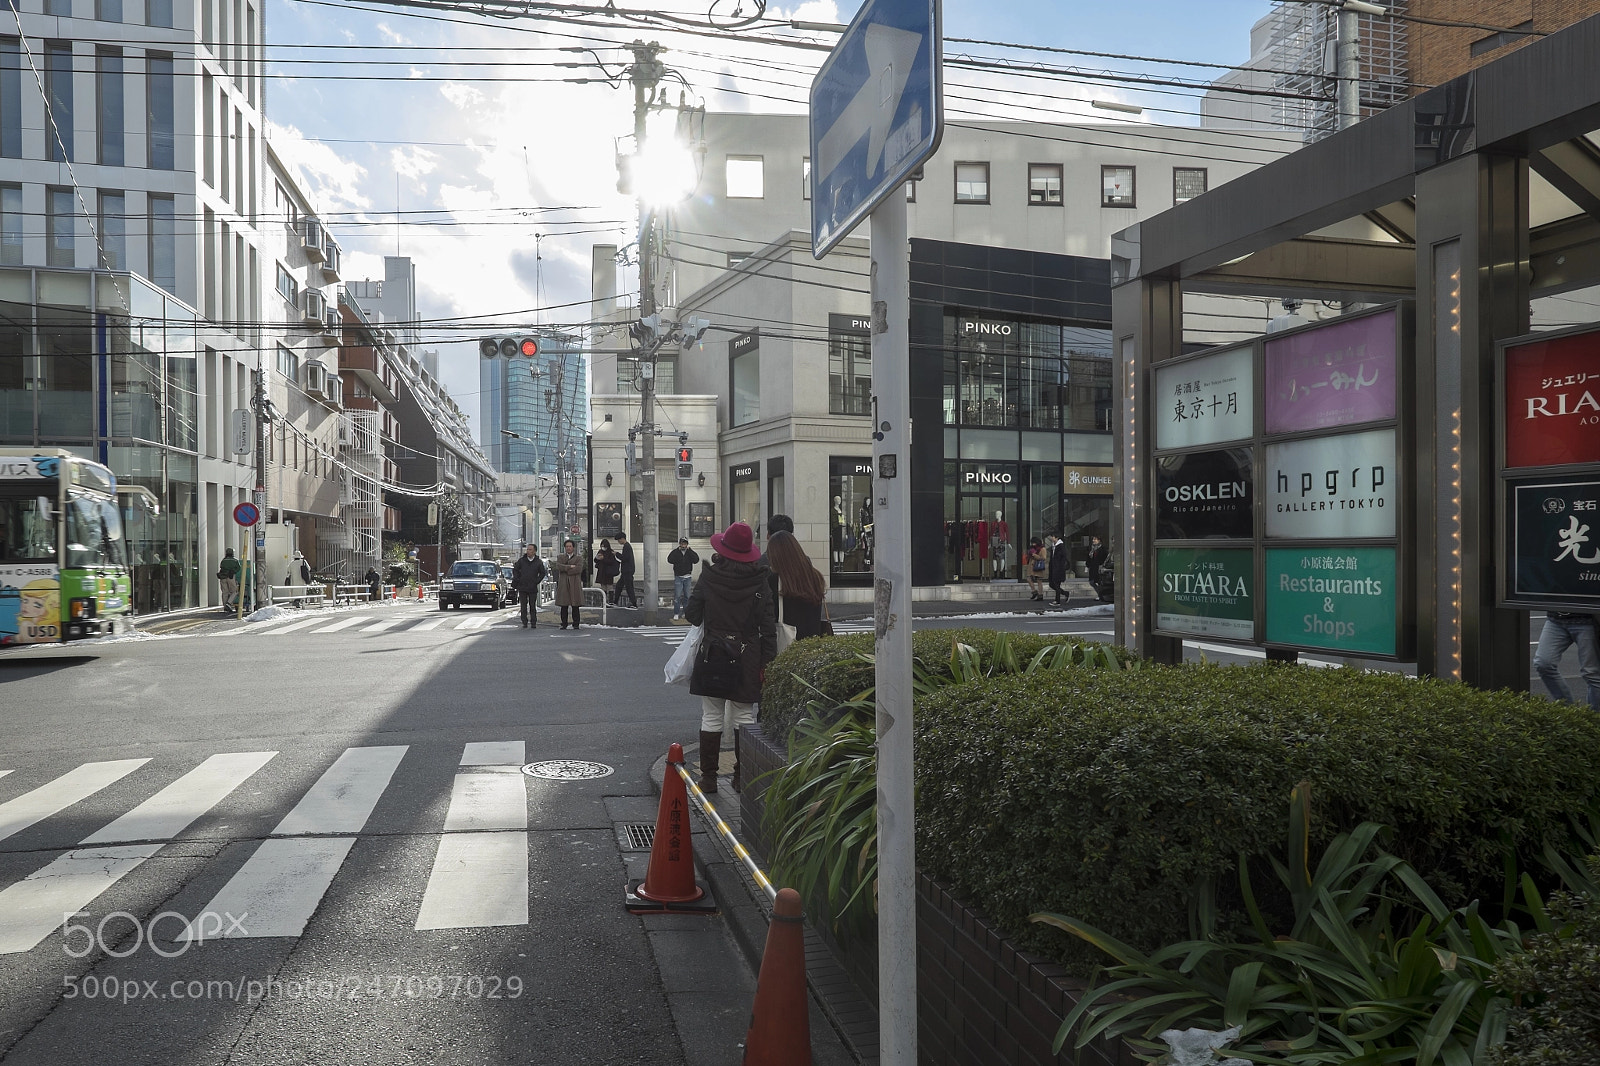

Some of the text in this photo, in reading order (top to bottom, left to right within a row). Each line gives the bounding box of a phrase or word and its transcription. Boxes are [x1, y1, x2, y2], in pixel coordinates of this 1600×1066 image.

[966, 322, 1012, 335] PINKO
[734, 336, 751, 349] PINKO
[1174, 380, 1202, 396] 居酒屋
[1541, 372, 1600, 389] ジュエリー
[1173, 392, 1238, 423] 東京十月
[1524, 390, 1600, 420] RIA
[1580, 415, 1600, 425] AO
[735, 467, 752, 477] PINKO
[966, 472, 1012, 483] PINKO
[1081, 476, 1112, 484] GUNHEE
[1278, 465, 1385, 498] hpgrp
[1165, 481, 1246, 502] OSKLEN
[1202, 504, 1236, 512] Janeiro
[1277, 497, 1385, 513] GALLERY TOKYO
[1573, 500, 1597, 511] 宝石
[1553, 515, 1600, 564] 光
[1187, 562, 1225, 571] インド料理
[1300, 556, 1358, 570] 小原流会館
[1162, 572, 1249, 597] SITAARA
[1280, 573, 1383, 596] Restaurants
[1323, 597, 1335, 613] &
[27, 625, 58, 638] USD
[1303, 614, 1355, 640] Shops
